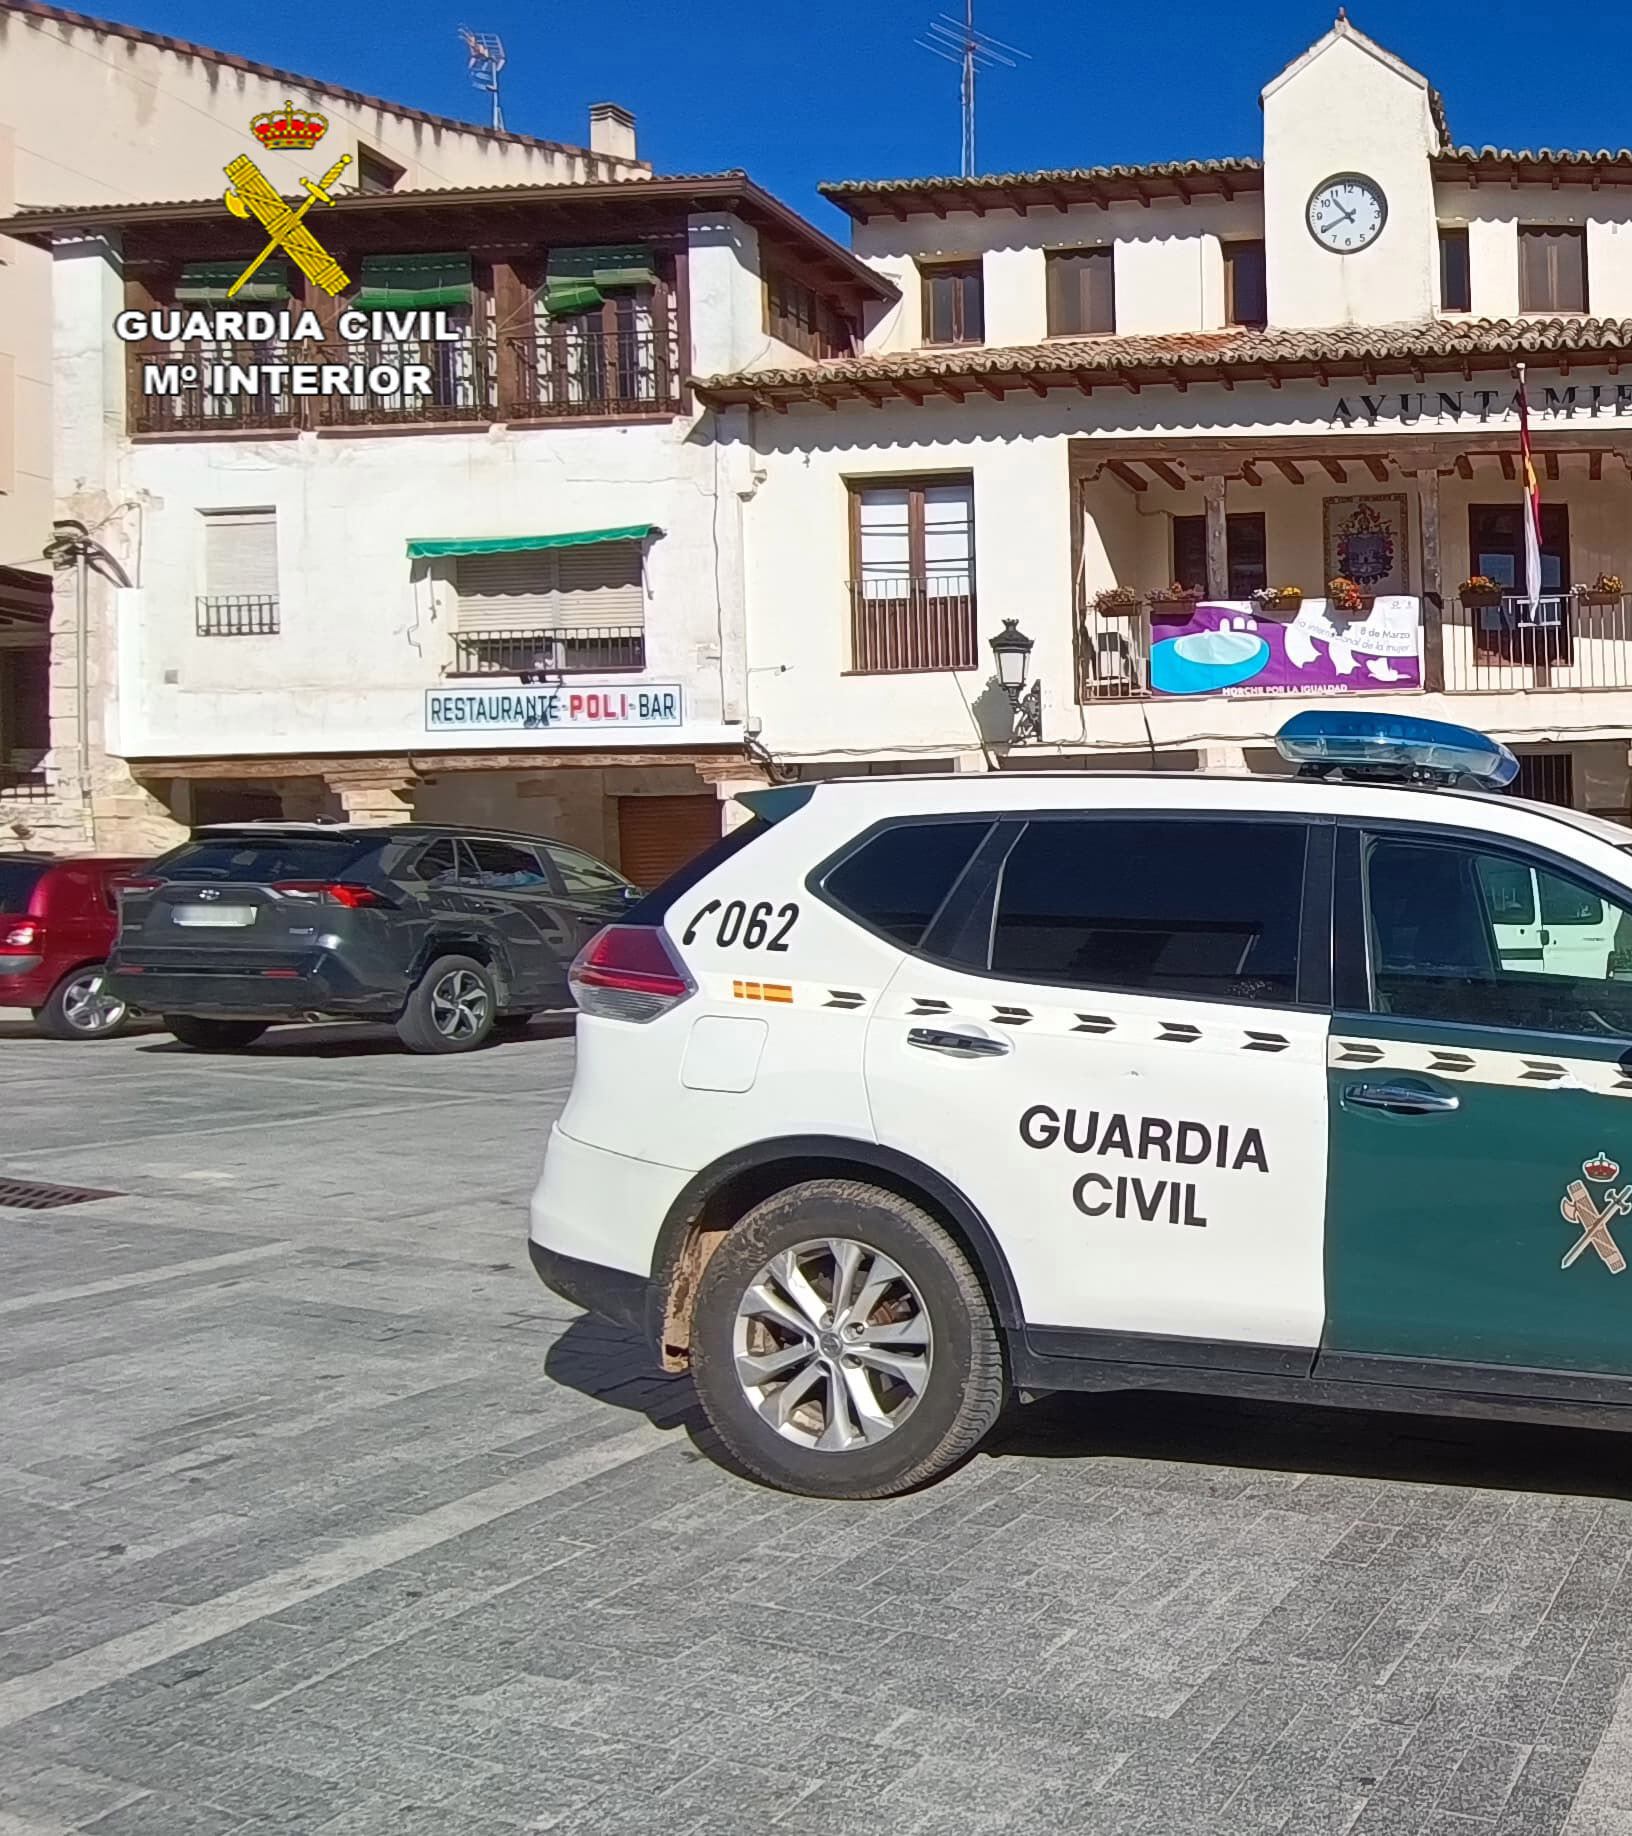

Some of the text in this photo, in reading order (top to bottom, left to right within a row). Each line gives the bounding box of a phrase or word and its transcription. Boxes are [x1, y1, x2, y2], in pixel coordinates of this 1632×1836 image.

[1330, 189, 1339, 198] 11
[1343, 184, 1354, 194] 12
[1321, 199, 1331, 208] 10
[1369, 197, 1376, 206] 2
[1316, 212, 1323, 221] 9
[1373, 210, 1381, 219] 3
[1369, 223, 1376, 231] 4
[1331, 234, 1338, 243] 7
[1344, 238, 1352, 246] 6
[1359, 234, 1366, 243] 5
[716, 900, 800, 952] 062
[1019, 1104, 1269, 1173] GUARDIA
[1072, 1172, 1207, 1228] CIVIL
